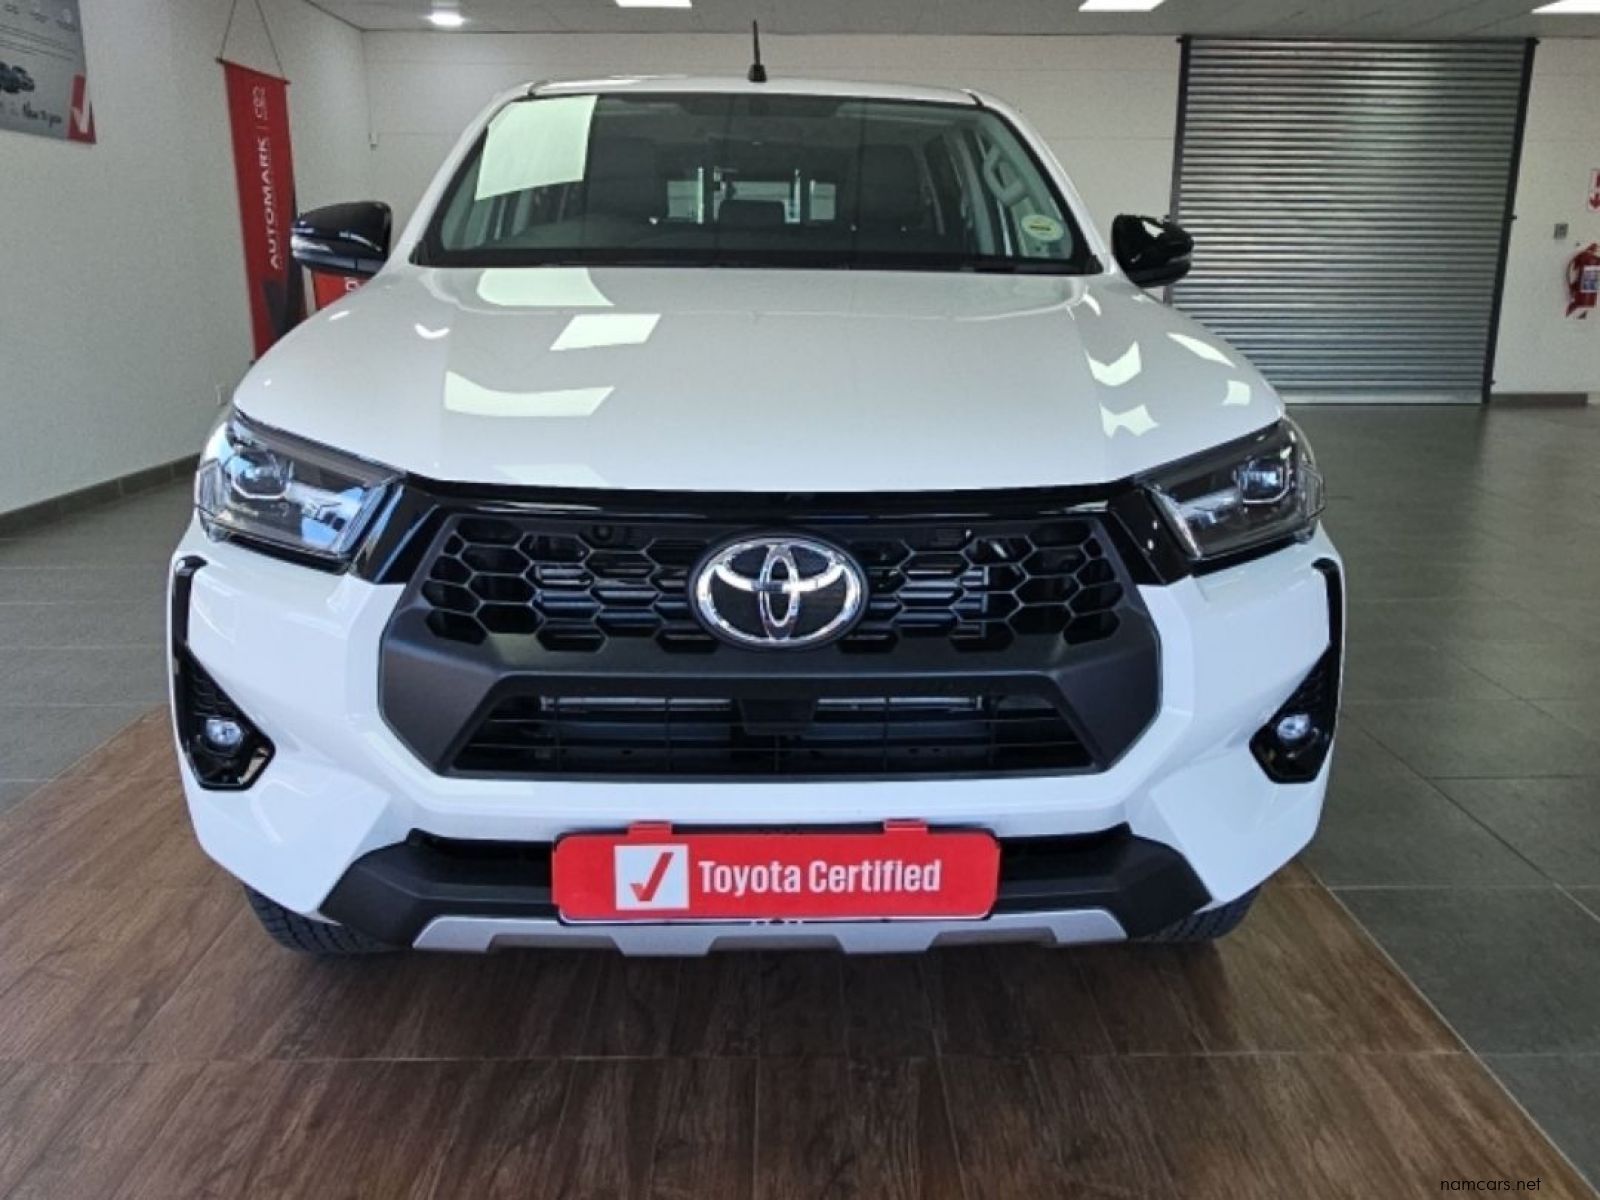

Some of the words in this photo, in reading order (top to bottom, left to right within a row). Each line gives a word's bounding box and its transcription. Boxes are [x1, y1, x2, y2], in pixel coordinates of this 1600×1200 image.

[257, 136, 283, 270] AUTOMARK
[698, 860, 801, 897] Toyota
[808, 859, 941, 893] Certified
